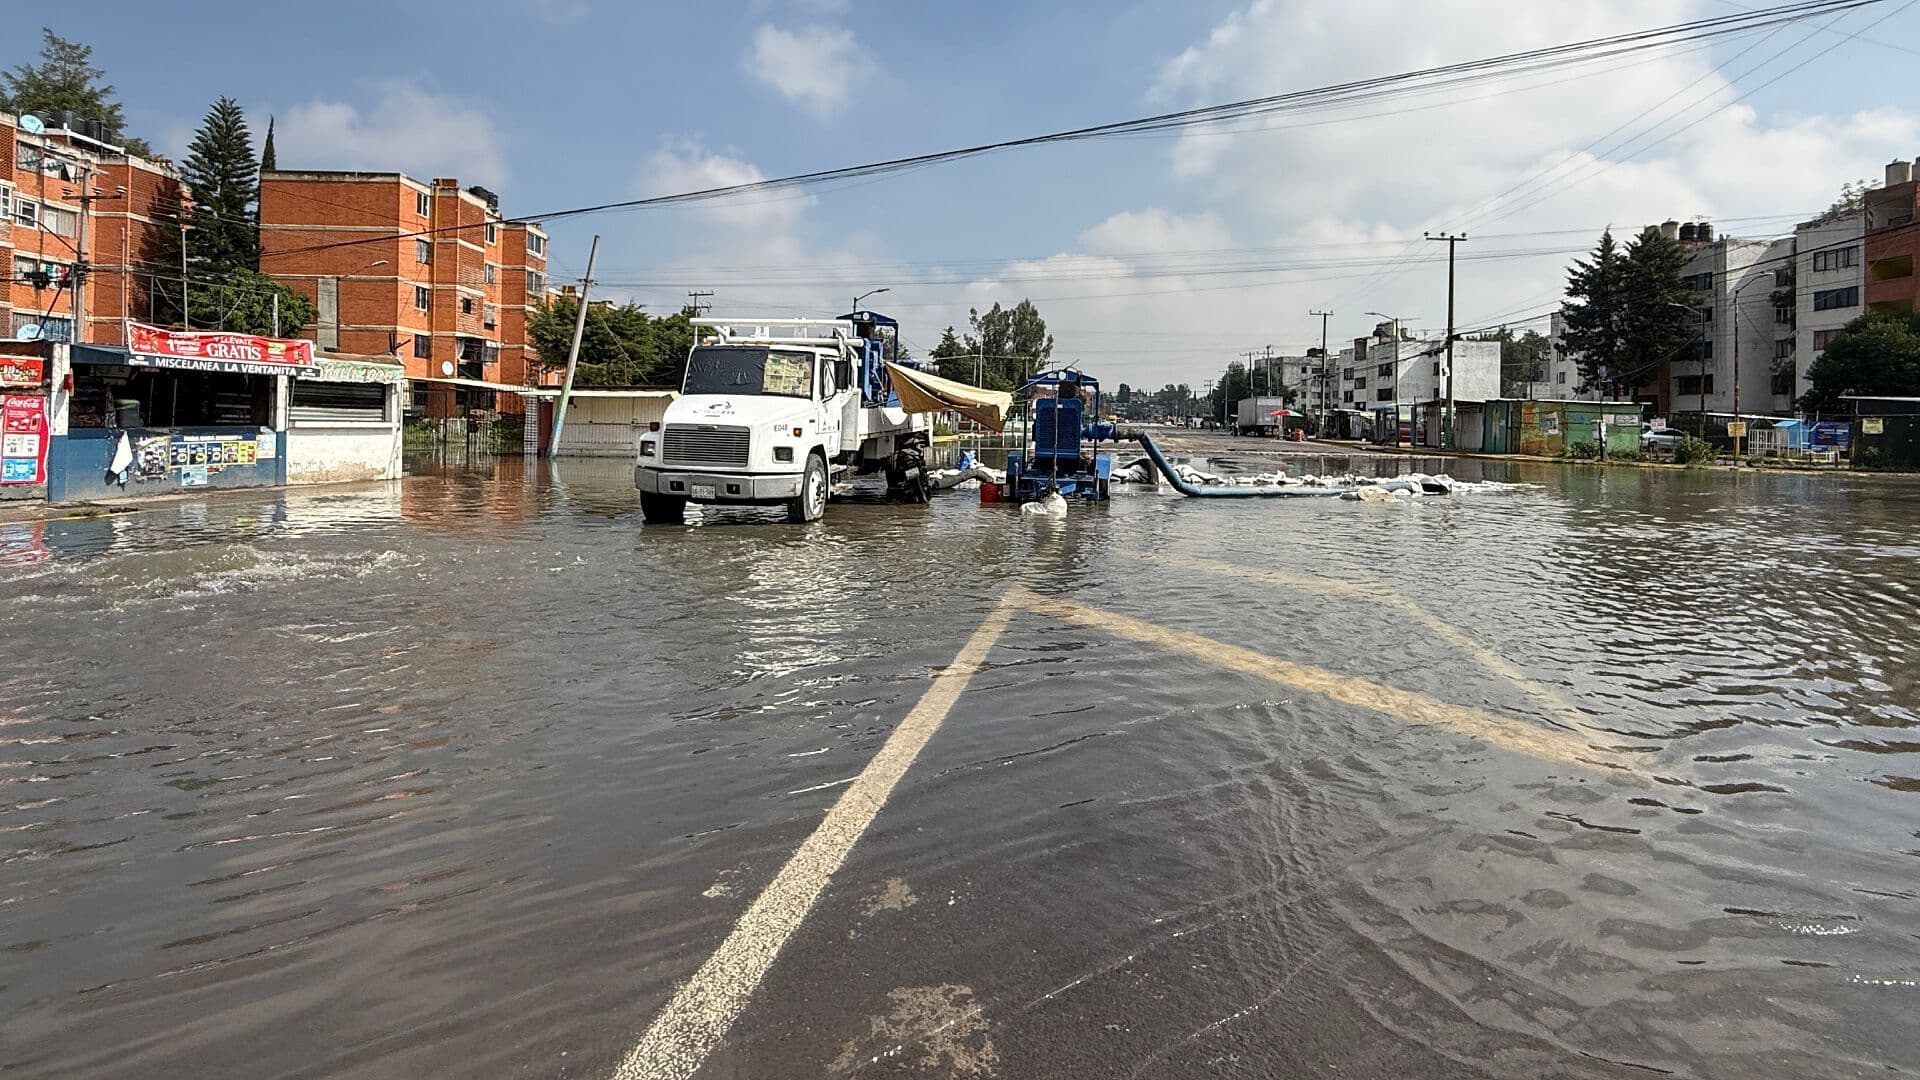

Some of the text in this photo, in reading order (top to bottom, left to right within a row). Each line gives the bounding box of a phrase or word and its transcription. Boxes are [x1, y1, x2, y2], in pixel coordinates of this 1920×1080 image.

[206, 343, 262, 360] GRATIS
[155, 357, 219, 372] MISCELANEA
[224, 362, 239, 372] LA
[241, 364, 297, 376] VENTANITA
[6, 397, 40, 409] Coca-Cola
